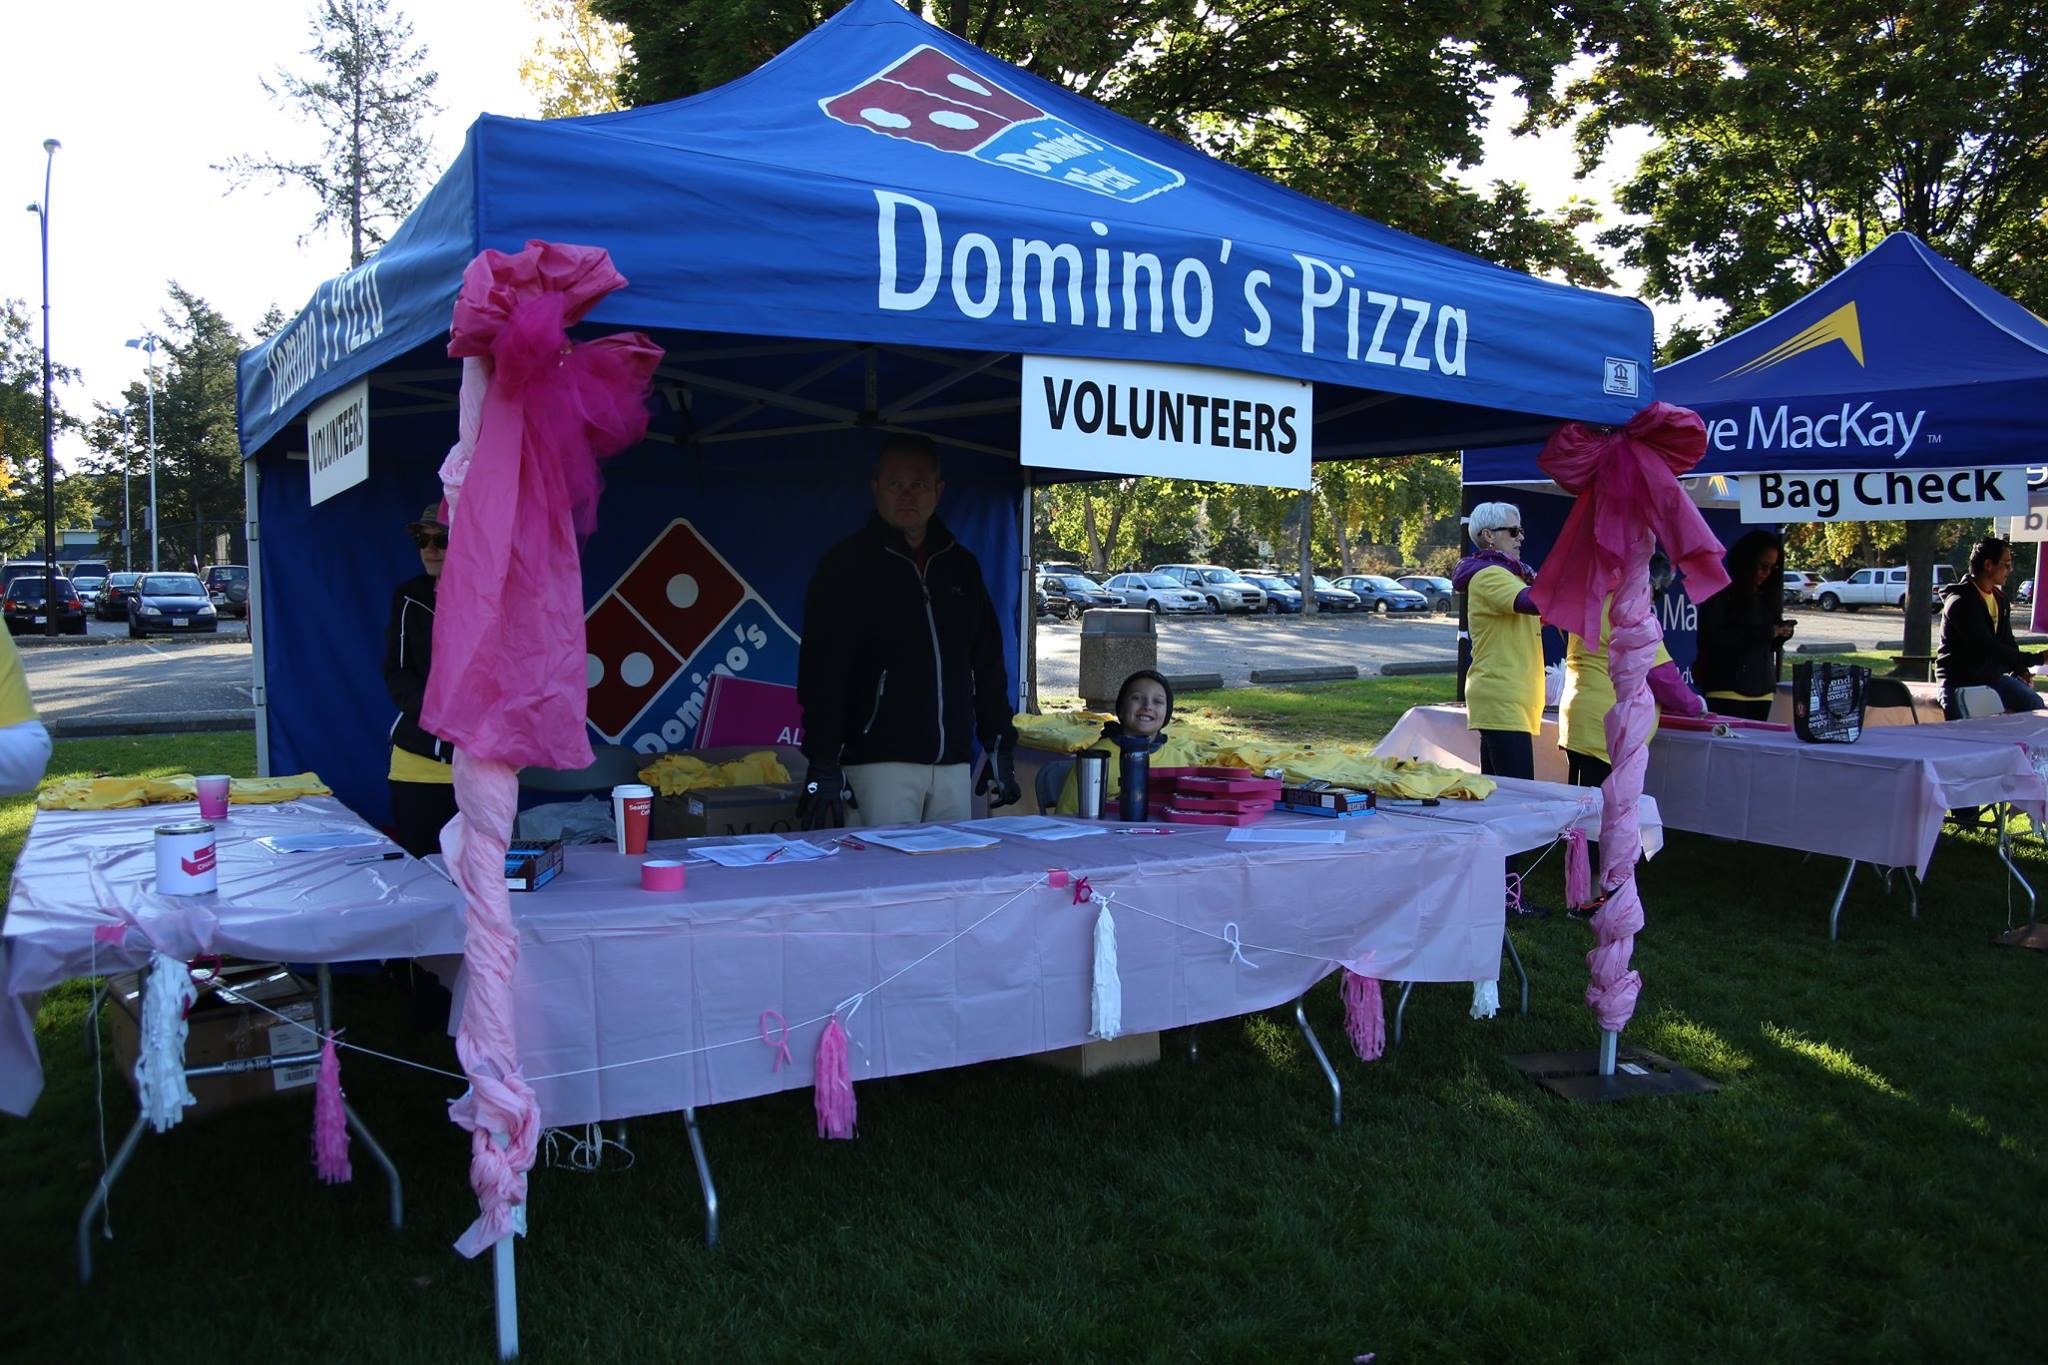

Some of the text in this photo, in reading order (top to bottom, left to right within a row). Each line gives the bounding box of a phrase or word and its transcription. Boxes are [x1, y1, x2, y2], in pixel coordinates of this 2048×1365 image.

[873, 189, 1468, 376] Domino's Pizza
[311, 397, 364, 474] VOLUNTEERS
[1043, 376, 1298, 455] VOLUNTEERS
[1747, 401, 1926, 460] MacKay
[1759, 472, 1840, 518] Bag
[1853, 469, 2006, 506] Check
